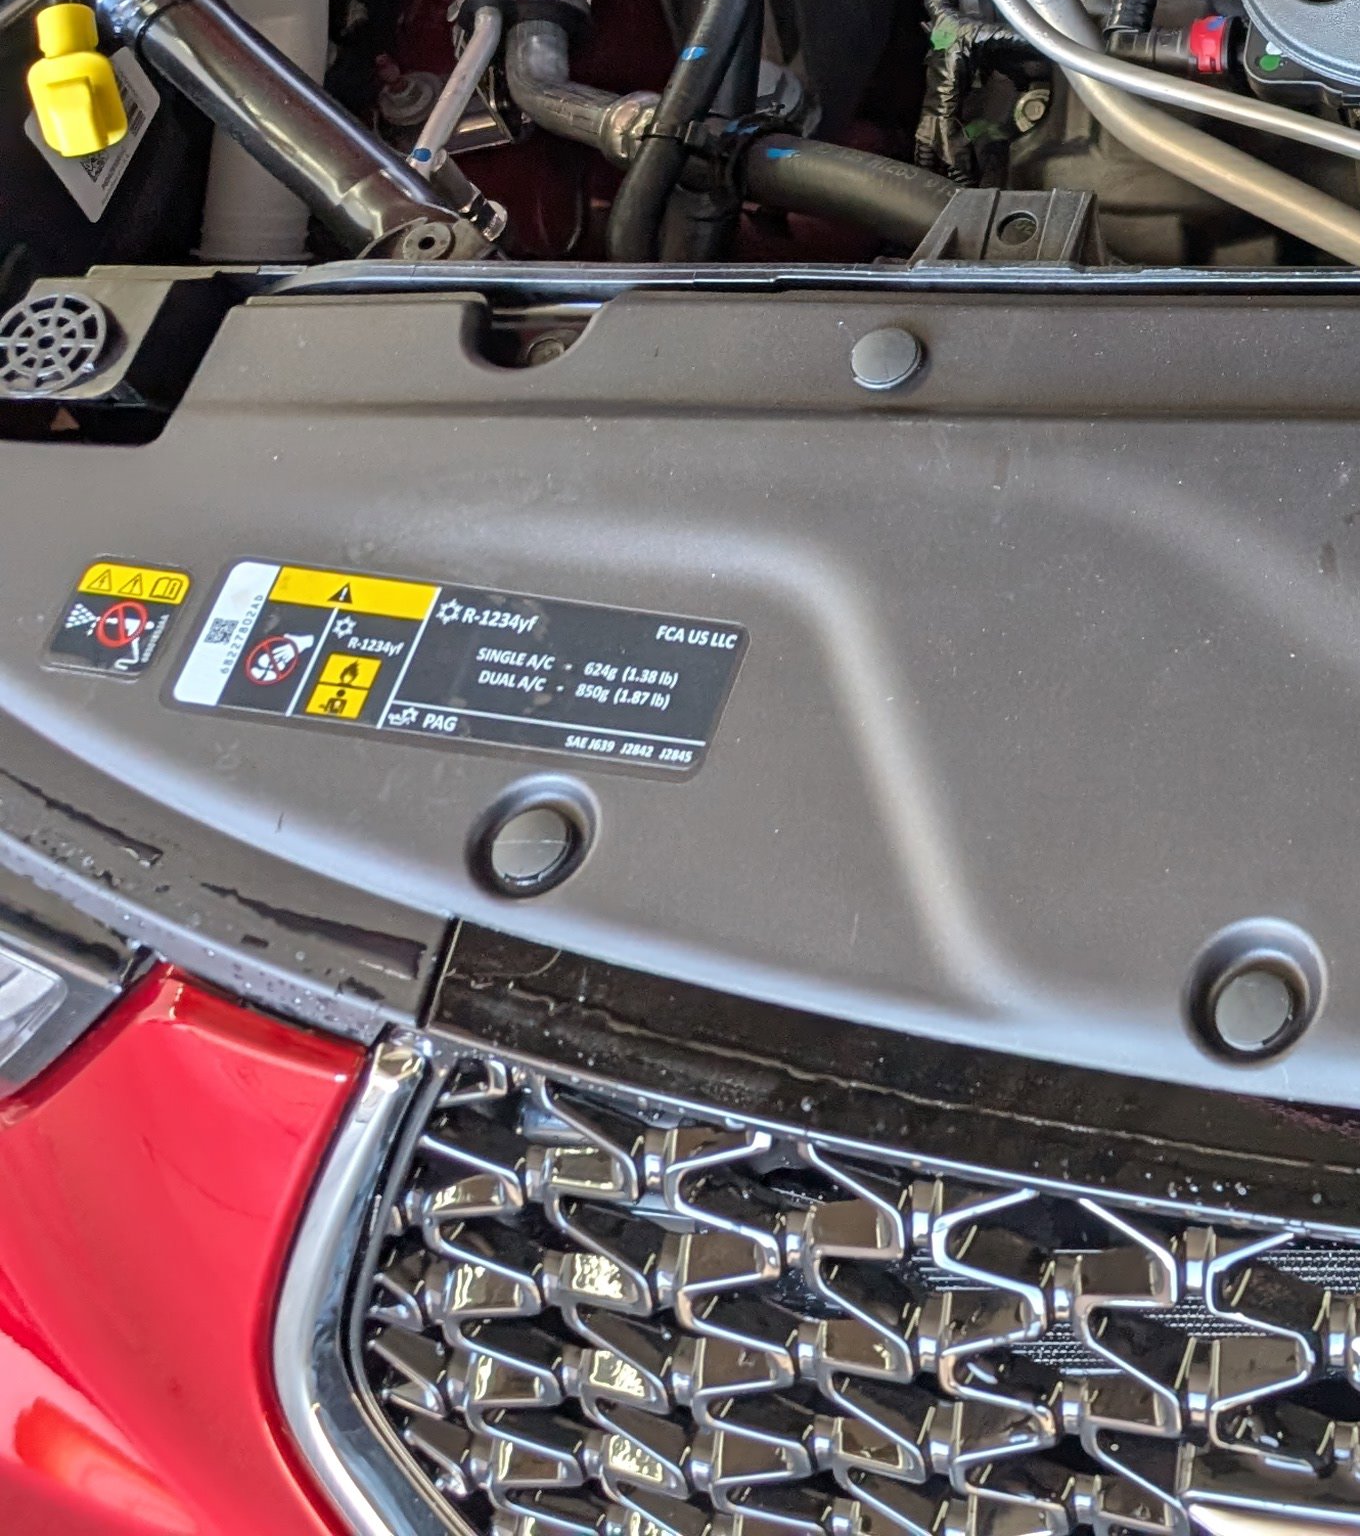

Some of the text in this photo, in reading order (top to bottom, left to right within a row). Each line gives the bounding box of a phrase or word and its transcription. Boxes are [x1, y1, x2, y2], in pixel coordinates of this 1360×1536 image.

[462, 607, 539, 634] R-1234yf
[347, 636, 405, 657] R-1234yf
[655, 625, 738, 650] FCA US LLC
[476, 647, 525, 667] SINGLE
[525, 654, 555, 671] A/C
[584, 661, 618, 682] 624g
[621, 665, 657, 685] (1.38
[657, 669, 679, 689] lb)
[478, 670, 516, 688] DUAL
[517, 675, 547, 692] A/C
[575, 683, 610, 703] 850g
[613, 687, 650, 706] (1.87
[650, 691, 671, 711] lb)
[422, 712, 458, 733] PAG
[565, 735, 693, 764] SAE J639 J2842 J2845
